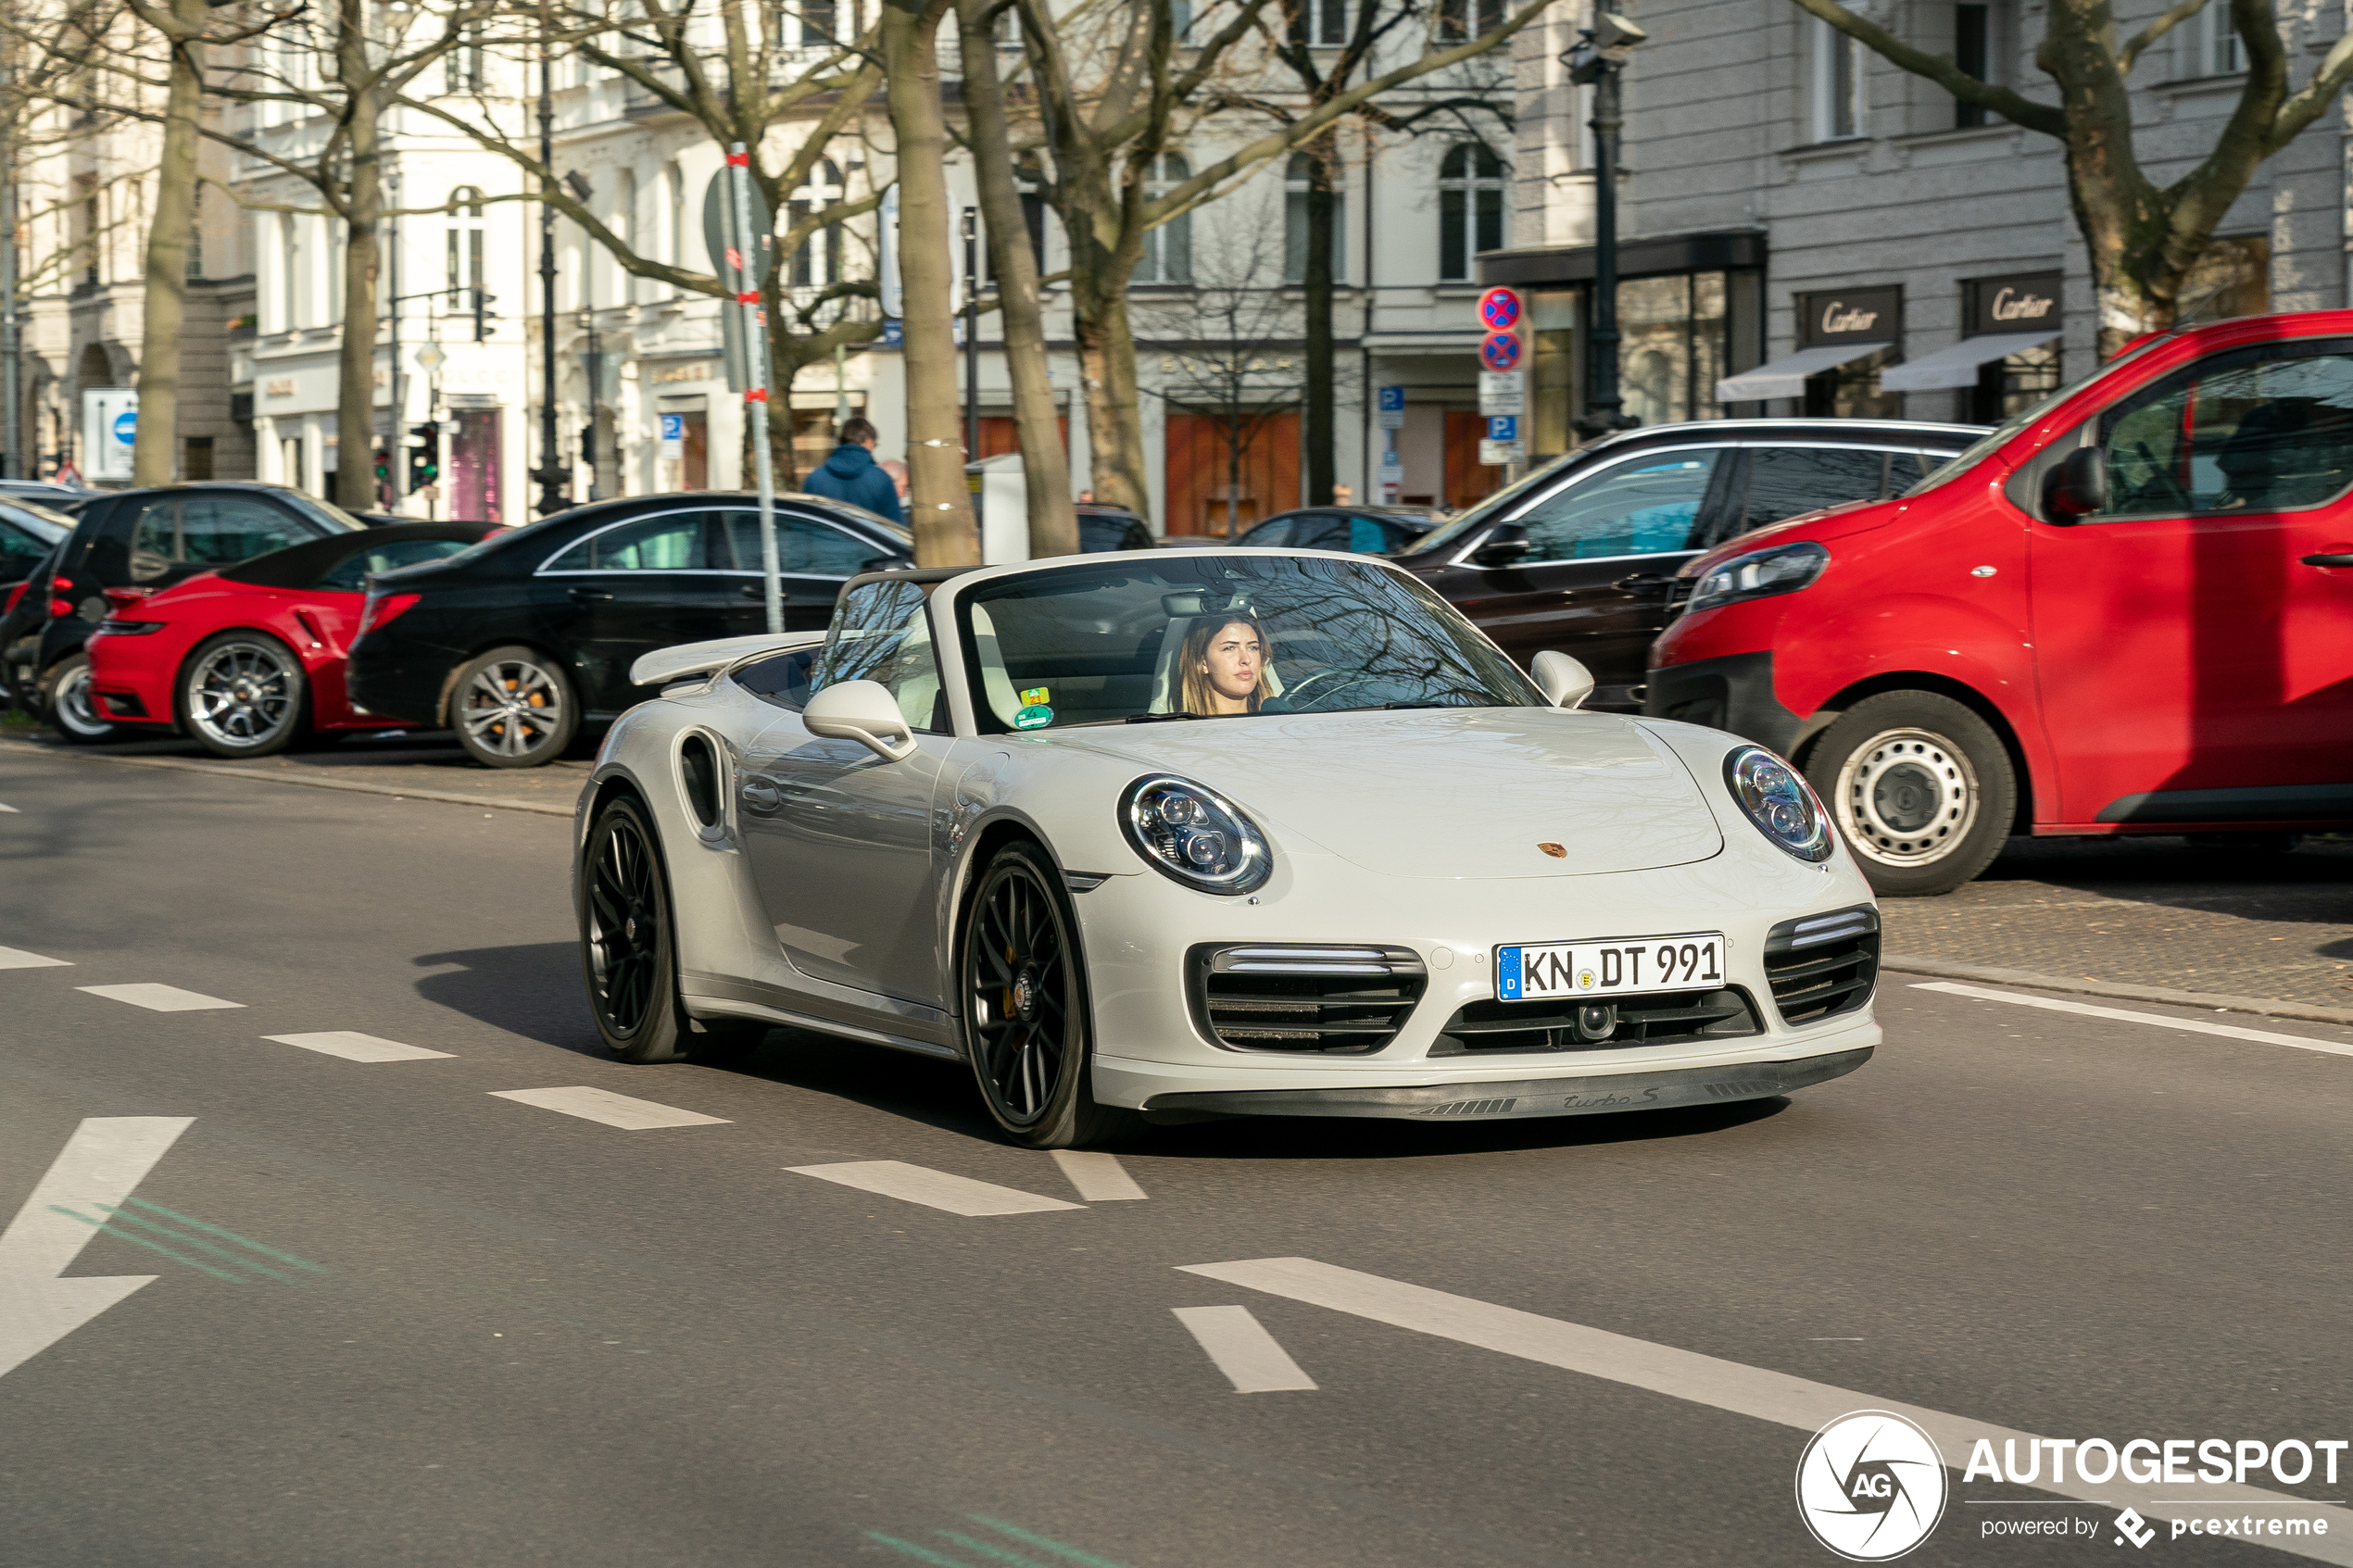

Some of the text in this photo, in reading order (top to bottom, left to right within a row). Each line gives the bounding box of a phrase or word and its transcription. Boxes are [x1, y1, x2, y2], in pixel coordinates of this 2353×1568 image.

[1992, 286, 2054, 320] Cartier
[1821, 301, 1878, 333] Cartier
[1029, 696, 1041, 704] 21
[1027, 708, 1038, 718] 4
[1524, 942, 1720, 991] KN DT 991
[1507, 979, 1516, 990] D
[1564, 1087, 1660, 1109] turbo S
